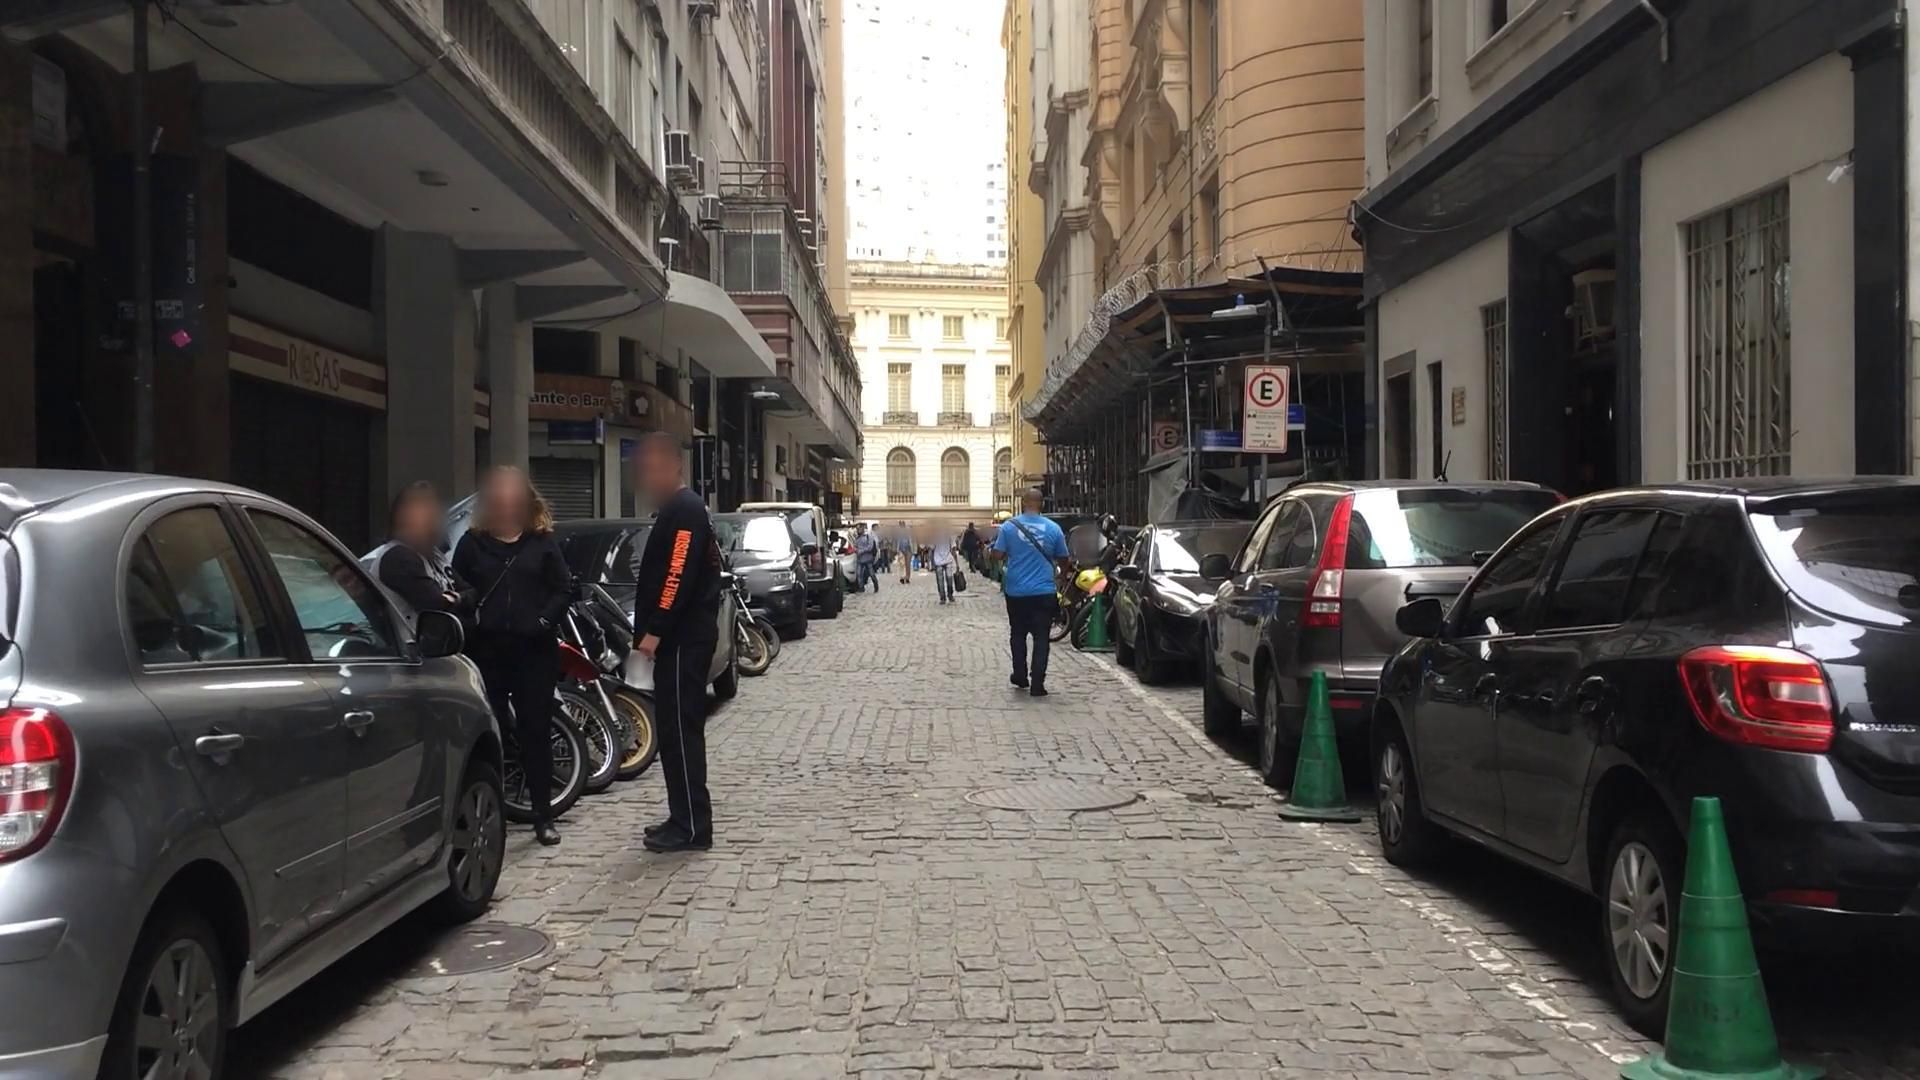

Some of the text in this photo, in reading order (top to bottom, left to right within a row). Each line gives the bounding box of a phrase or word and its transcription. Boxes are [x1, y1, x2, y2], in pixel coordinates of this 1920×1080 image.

[569, 394, 579, 406] e
[583, 393, 606, 407] Bar
[1260, 380, 1273, 400] E
[659, 530, 692, 610] HARLEY-DAVIDSON
